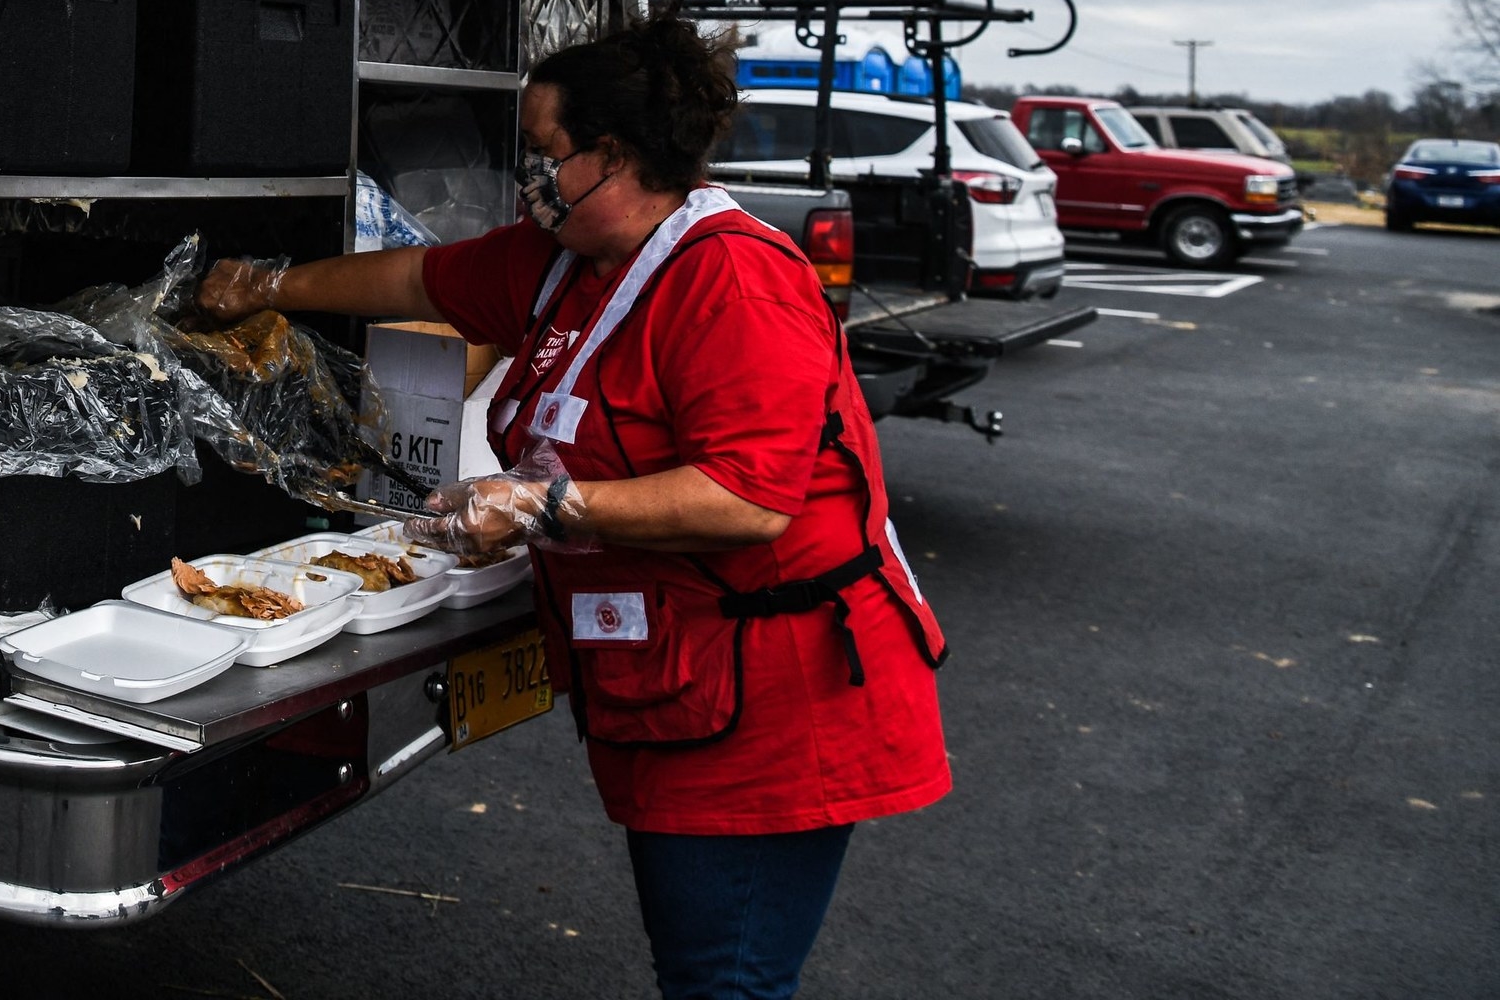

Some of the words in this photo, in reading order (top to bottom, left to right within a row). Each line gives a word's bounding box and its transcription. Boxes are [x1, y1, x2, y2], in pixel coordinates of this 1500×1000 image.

[546, 337, 566, 347] THE
[391, 432, 402, 459] 6
[408, 434, 443, 466] KIT
[389, 491, 404, 507] 250
[455, 670, 485, 722] B16
[501, 637, 550, 699] 3822
